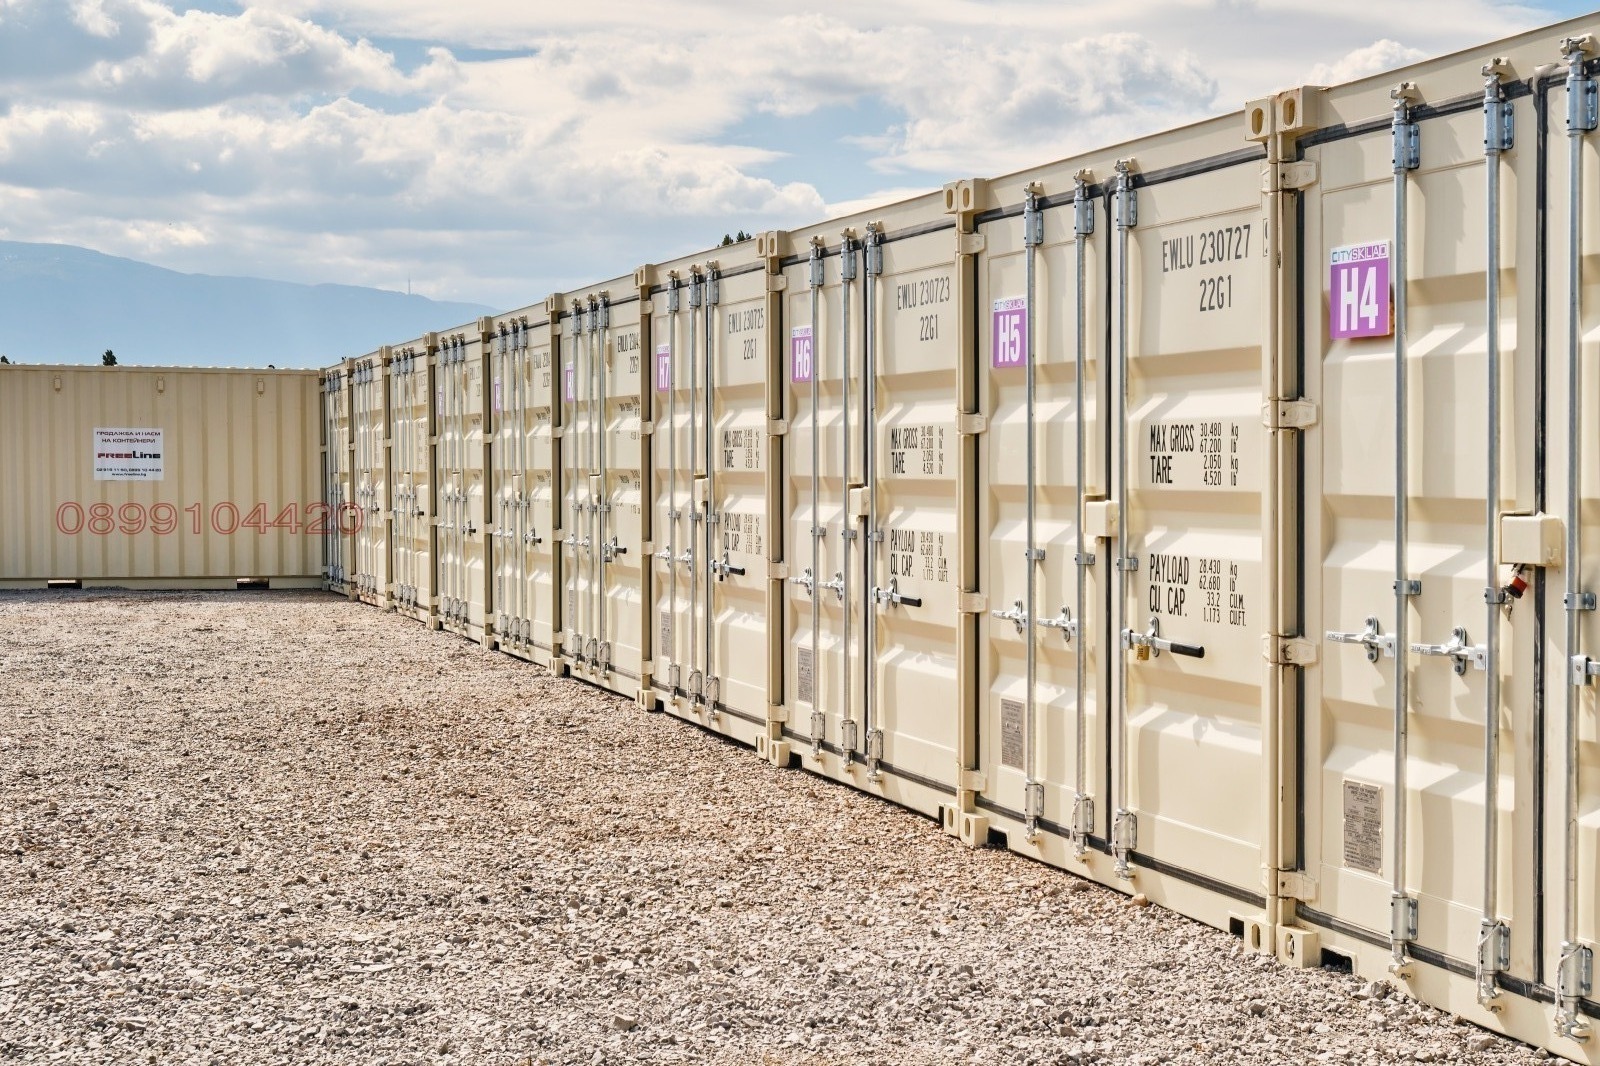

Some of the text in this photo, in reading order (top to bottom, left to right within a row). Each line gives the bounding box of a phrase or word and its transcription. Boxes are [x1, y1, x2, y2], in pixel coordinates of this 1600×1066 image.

[1162, 235, 1194, 272] EWLU
[1200, 224, 1250, 265] 230727
[1331, 244, 1387, 262] CITYSKLAD
[898, 276, 950, 310] EWLU 230723
[1200, 274, 1232, 312] 22G1
[1340, 266, 1378, 332] H4
[920, 314, 938, 342] 22G1
[998, 314, 1020, 362] H5
[796, 340, 810, 378] H6
[1150, 424, 1166, 452] MAX
[1170, 424, 1194, 452] GROSS
[1150, 456, 1172, 484] TARE
[1150, 554, 1190, 584] PAYLOAD
[1150, 585, 1162, 614] CU.
[1168, 587, 1188, 617] CAP.
